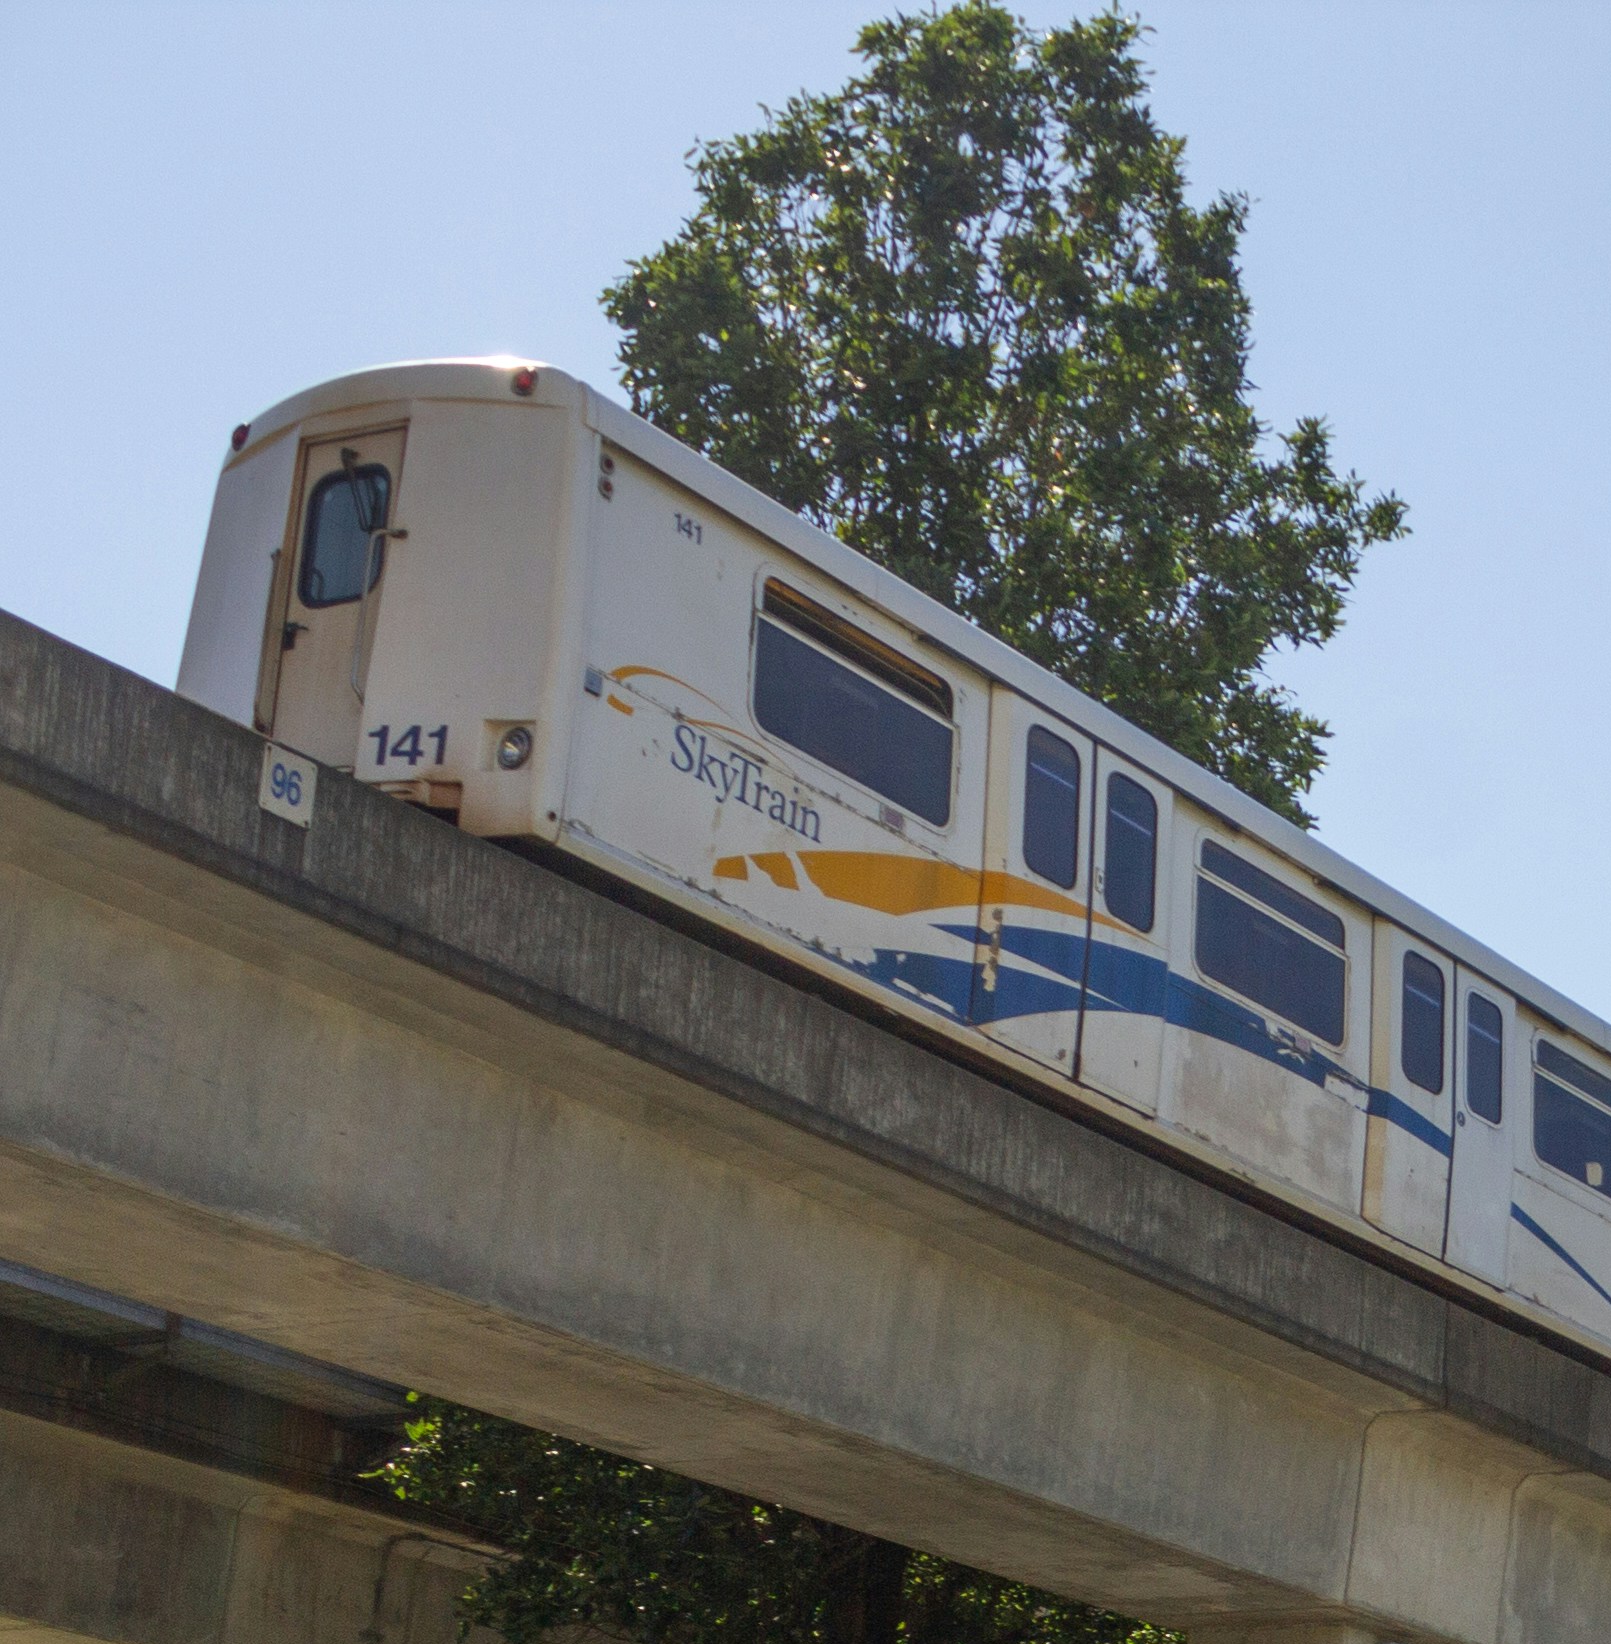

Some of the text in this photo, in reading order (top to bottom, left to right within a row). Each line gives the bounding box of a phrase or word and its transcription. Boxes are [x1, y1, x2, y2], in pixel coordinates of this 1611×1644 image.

[674, 513, 703, 545] 141
[367, 724, 448, 766] 141
[269, 762, 303, 807] 96
[670, 724, 823, 843] SkyTrain
